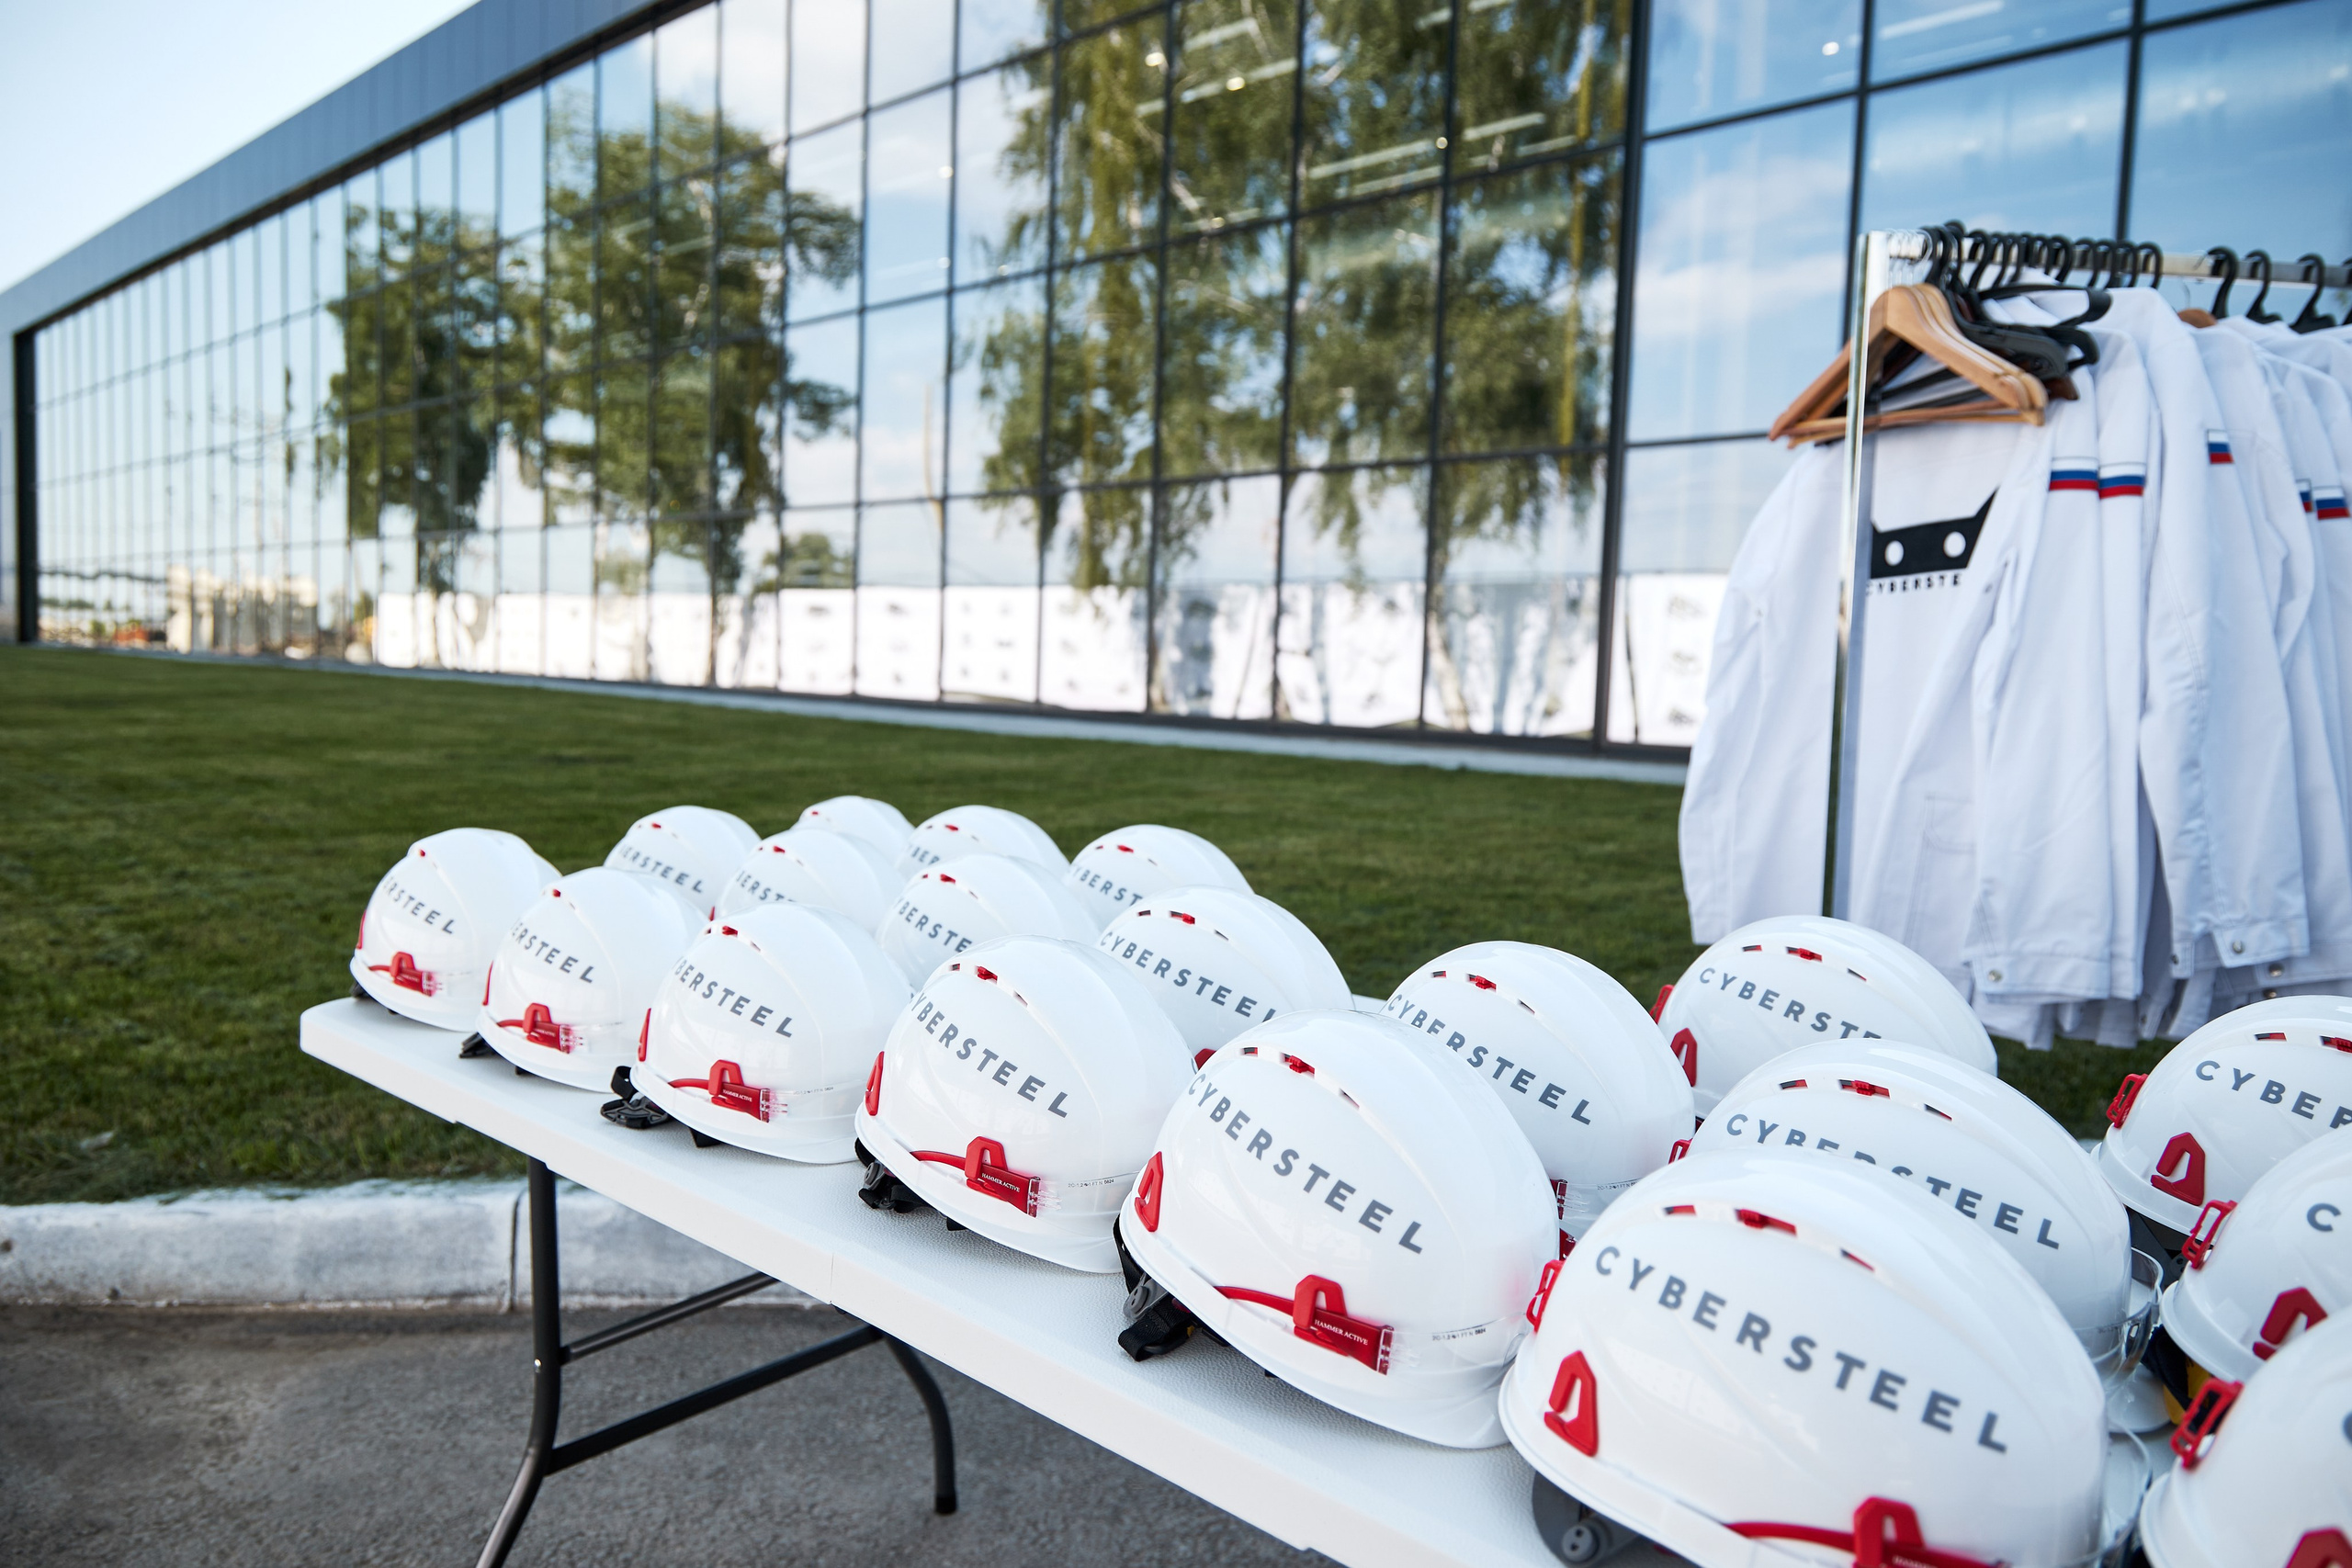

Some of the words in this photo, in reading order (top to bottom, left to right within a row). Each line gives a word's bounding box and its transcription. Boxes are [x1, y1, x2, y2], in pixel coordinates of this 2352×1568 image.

[620, 846, 704, 894] ERSTEEL
[1069, 865, 1143, 907] YBERST
[510, 918, 594, 984] ERSTEEL
[910, 992, 1069, 1119] YBERSTEEL
[1388, 994, 1591, 1126] CYBERSTEEL
[981, 1172, 1002, 1185] HAMMER
[1002, 1181, 1021, 1192] ACTIVE
[1188, 1073, 1424, 1255] CYBERSTEEL
[1315, 1319, 1343, 1336] HAMMER
[1343, 1331, 1369, 1346] ACTIVE
[1595, 1246, 2008, 1454] CYBERSTEEL
